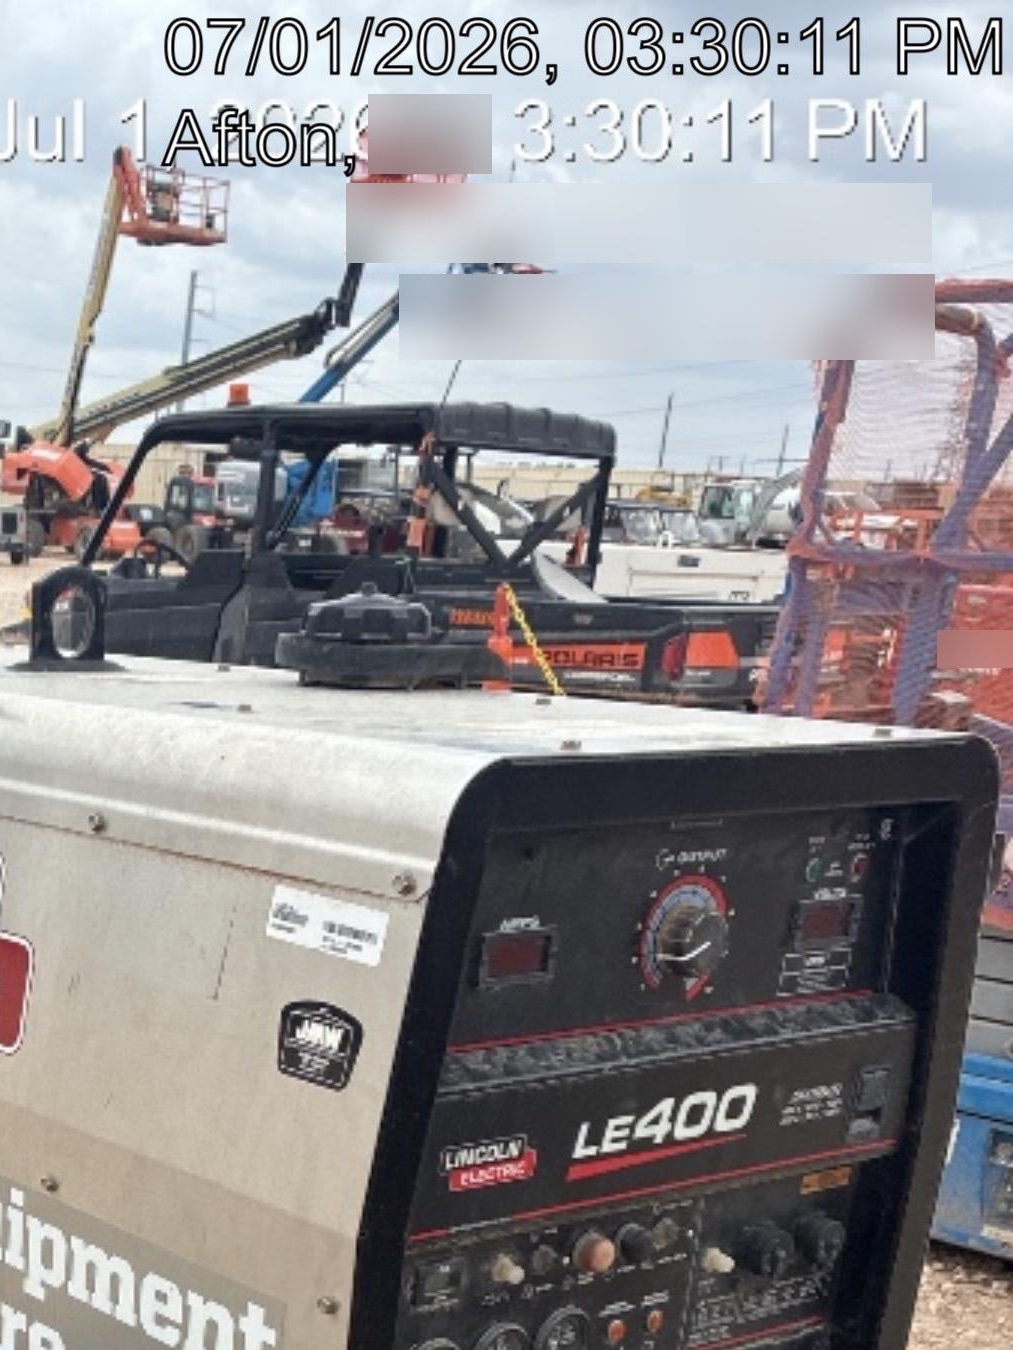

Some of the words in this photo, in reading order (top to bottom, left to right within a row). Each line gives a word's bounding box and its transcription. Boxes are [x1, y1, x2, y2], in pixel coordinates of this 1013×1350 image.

[571, 1082, 759, 1160] LE400
[445, 1138, 524, 1171] LINCOLN
[460, 1159, 526, 1186] ELECTRIC
